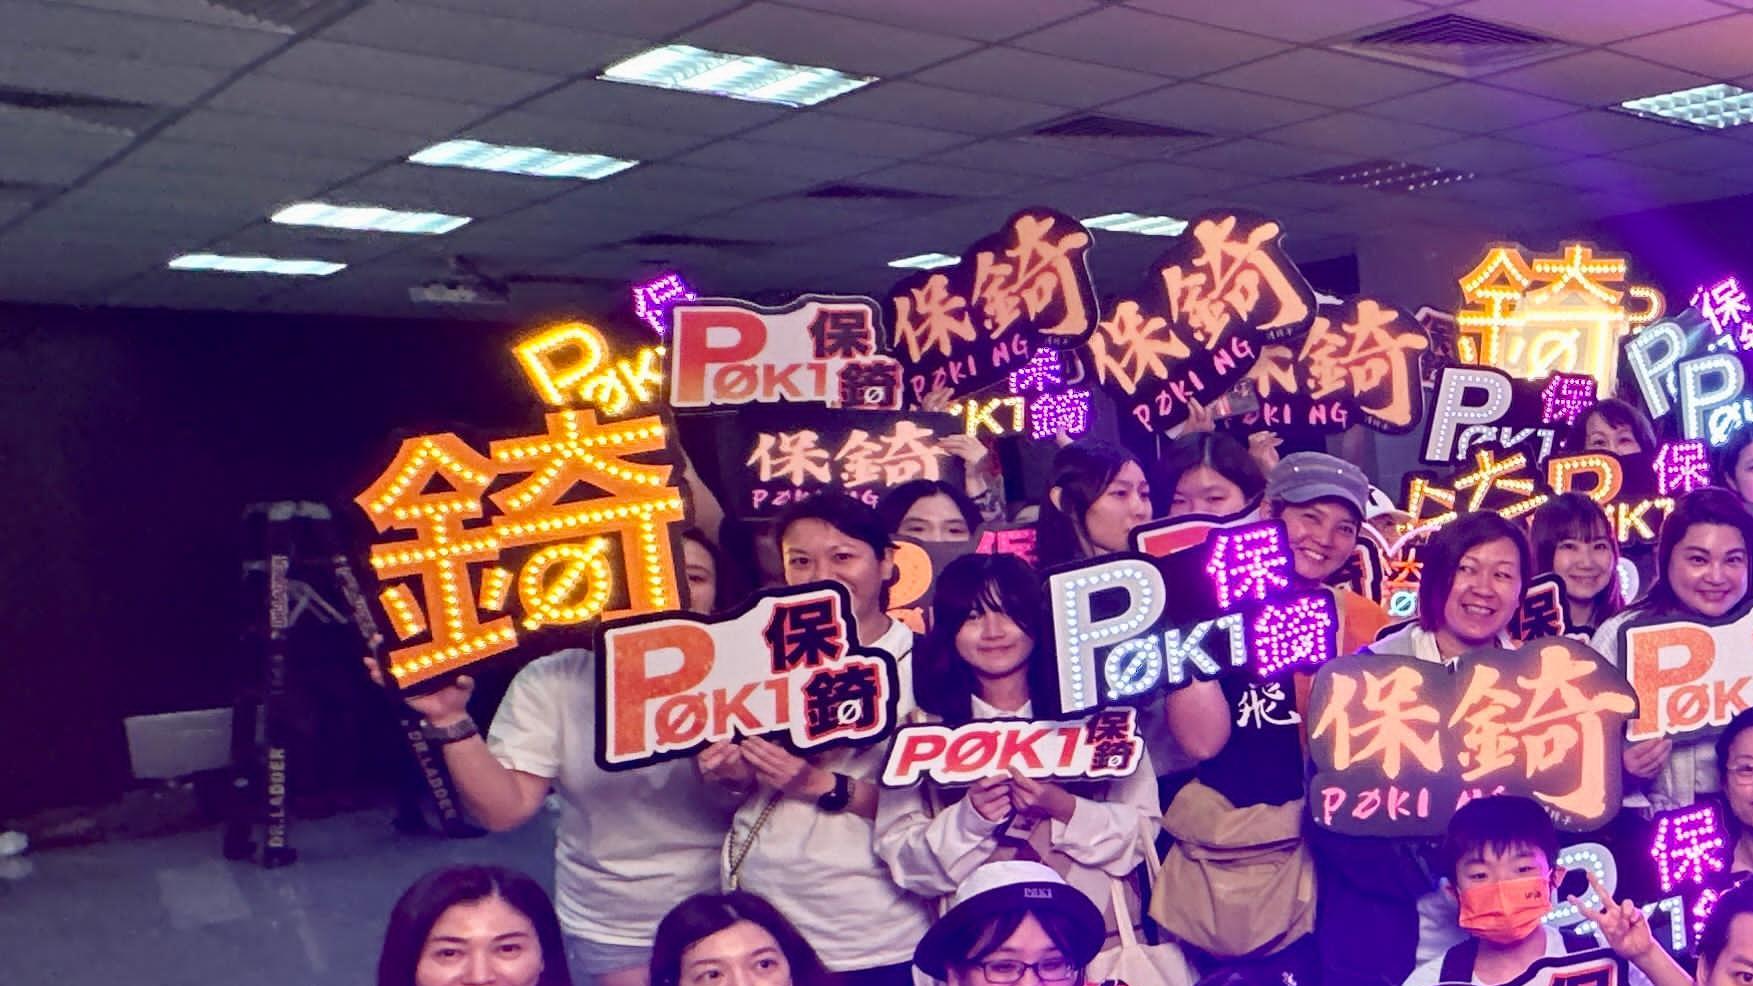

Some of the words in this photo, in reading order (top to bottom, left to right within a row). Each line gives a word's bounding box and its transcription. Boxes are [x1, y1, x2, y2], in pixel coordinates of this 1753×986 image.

[893, 215, 1088, 363] 保錡
[1089, 216, 1307, 395] 保錡
[513, 322, 667, 416] PØK
[1311, 648, 1636, 818] 保錡
